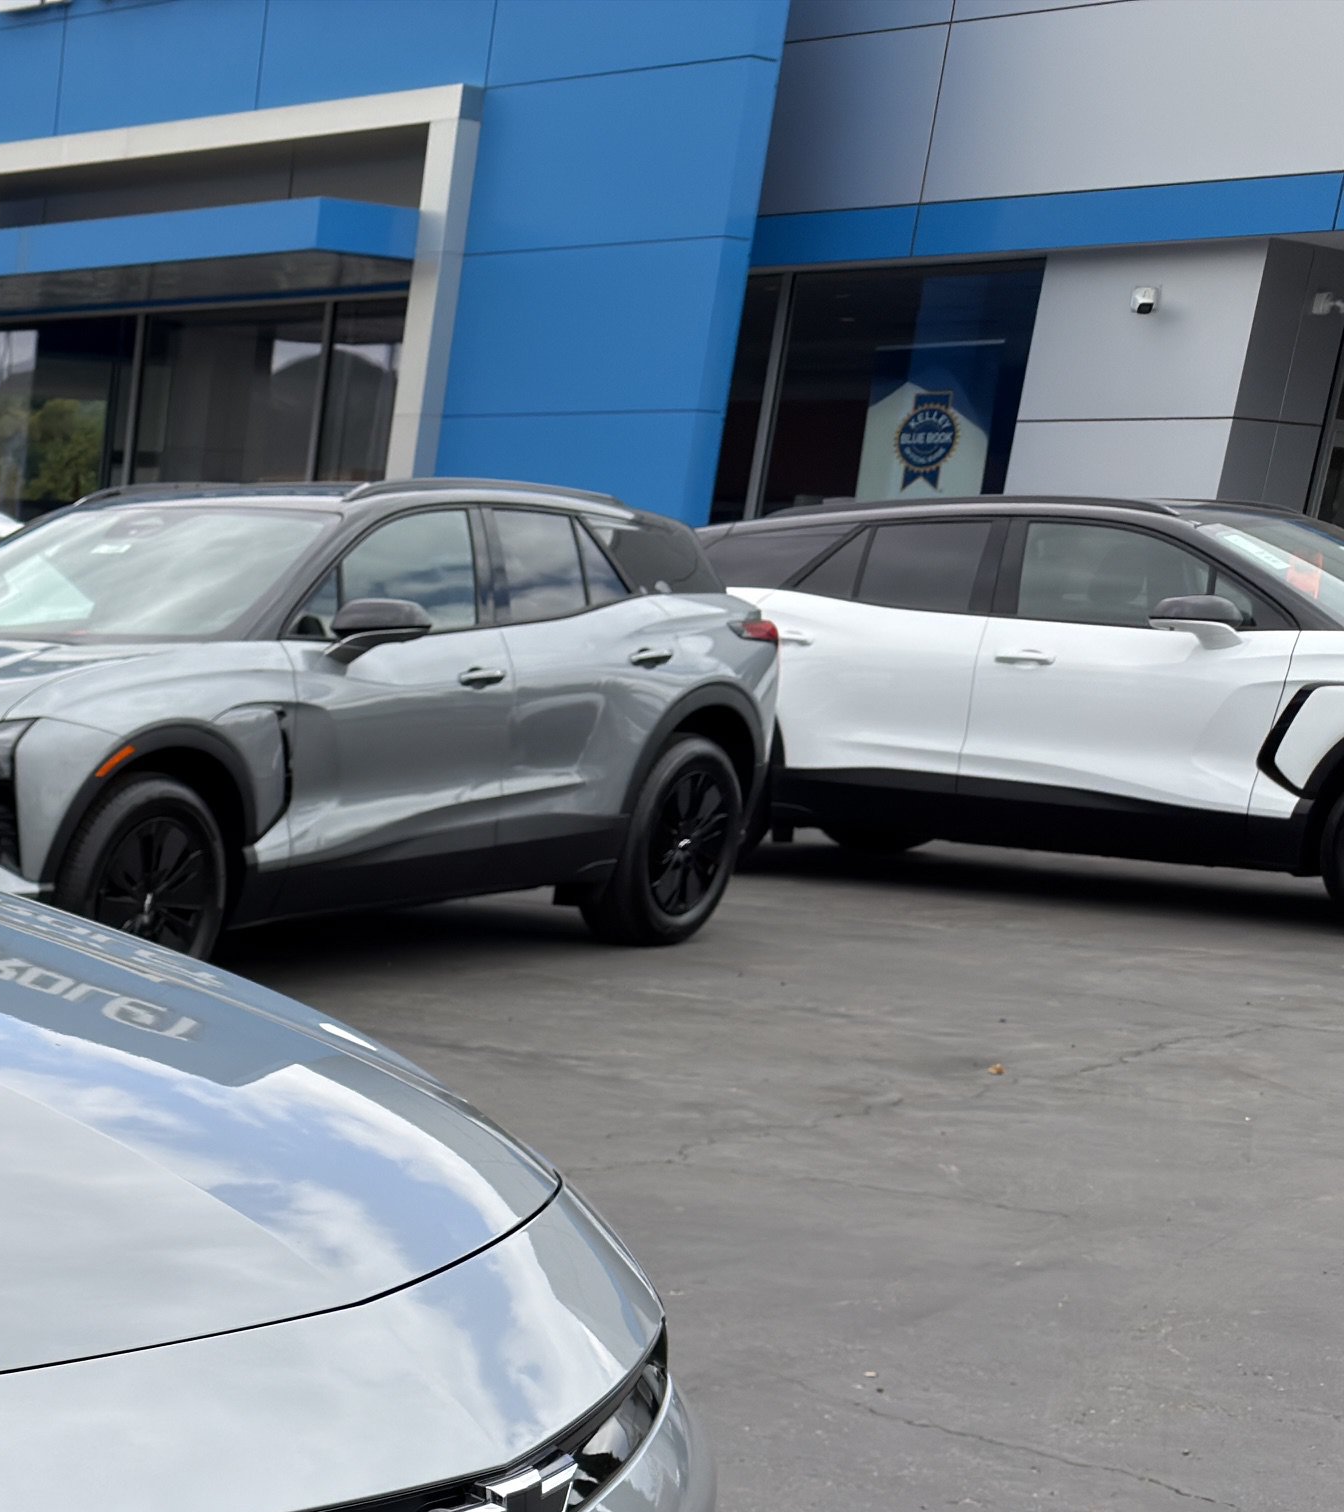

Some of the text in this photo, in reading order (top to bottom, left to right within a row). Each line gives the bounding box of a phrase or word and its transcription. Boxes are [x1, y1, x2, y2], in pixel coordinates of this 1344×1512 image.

[909, 410, 952, 429] KELLEY
[900, 432, 953, 444] BLUE BOOK
